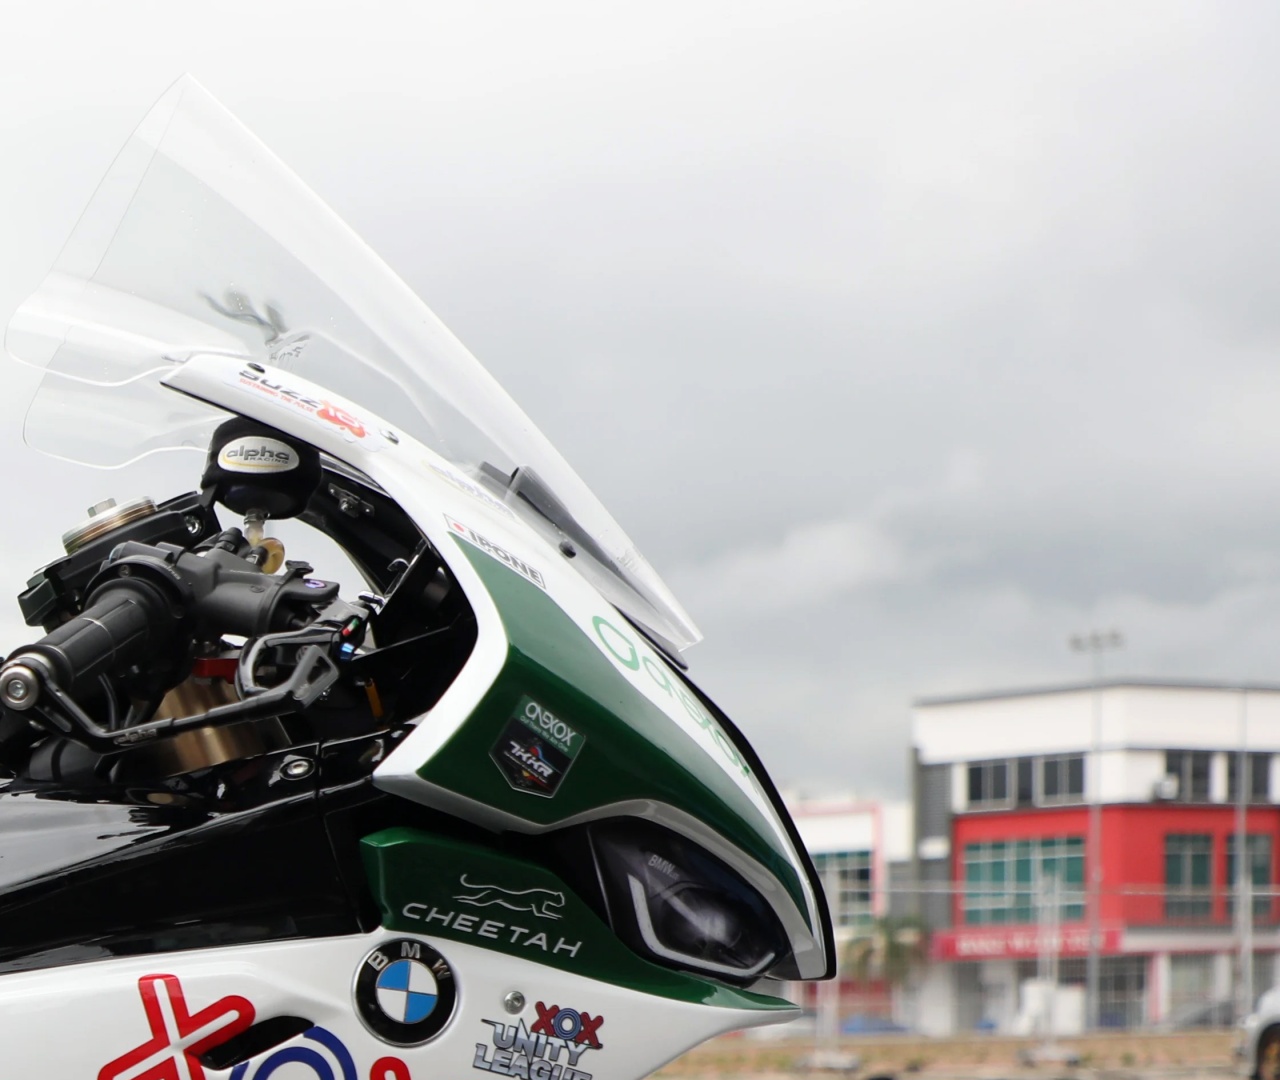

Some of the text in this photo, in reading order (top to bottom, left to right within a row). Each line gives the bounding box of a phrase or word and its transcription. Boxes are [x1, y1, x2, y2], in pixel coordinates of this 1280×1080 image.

[226, 445, 290, 461] alpha
[249, 456, 288, 464] RACING
[469, 530, 541, 585] IPONE
[525, 702, 576, 746] ONEXOX
[402, 903, 581, 957] CHEETAH
[367, 942, 451, 980] BMW
[481, 1018, 603, 1066] UNITY
[531, 1001, 604, 1049] XOX
